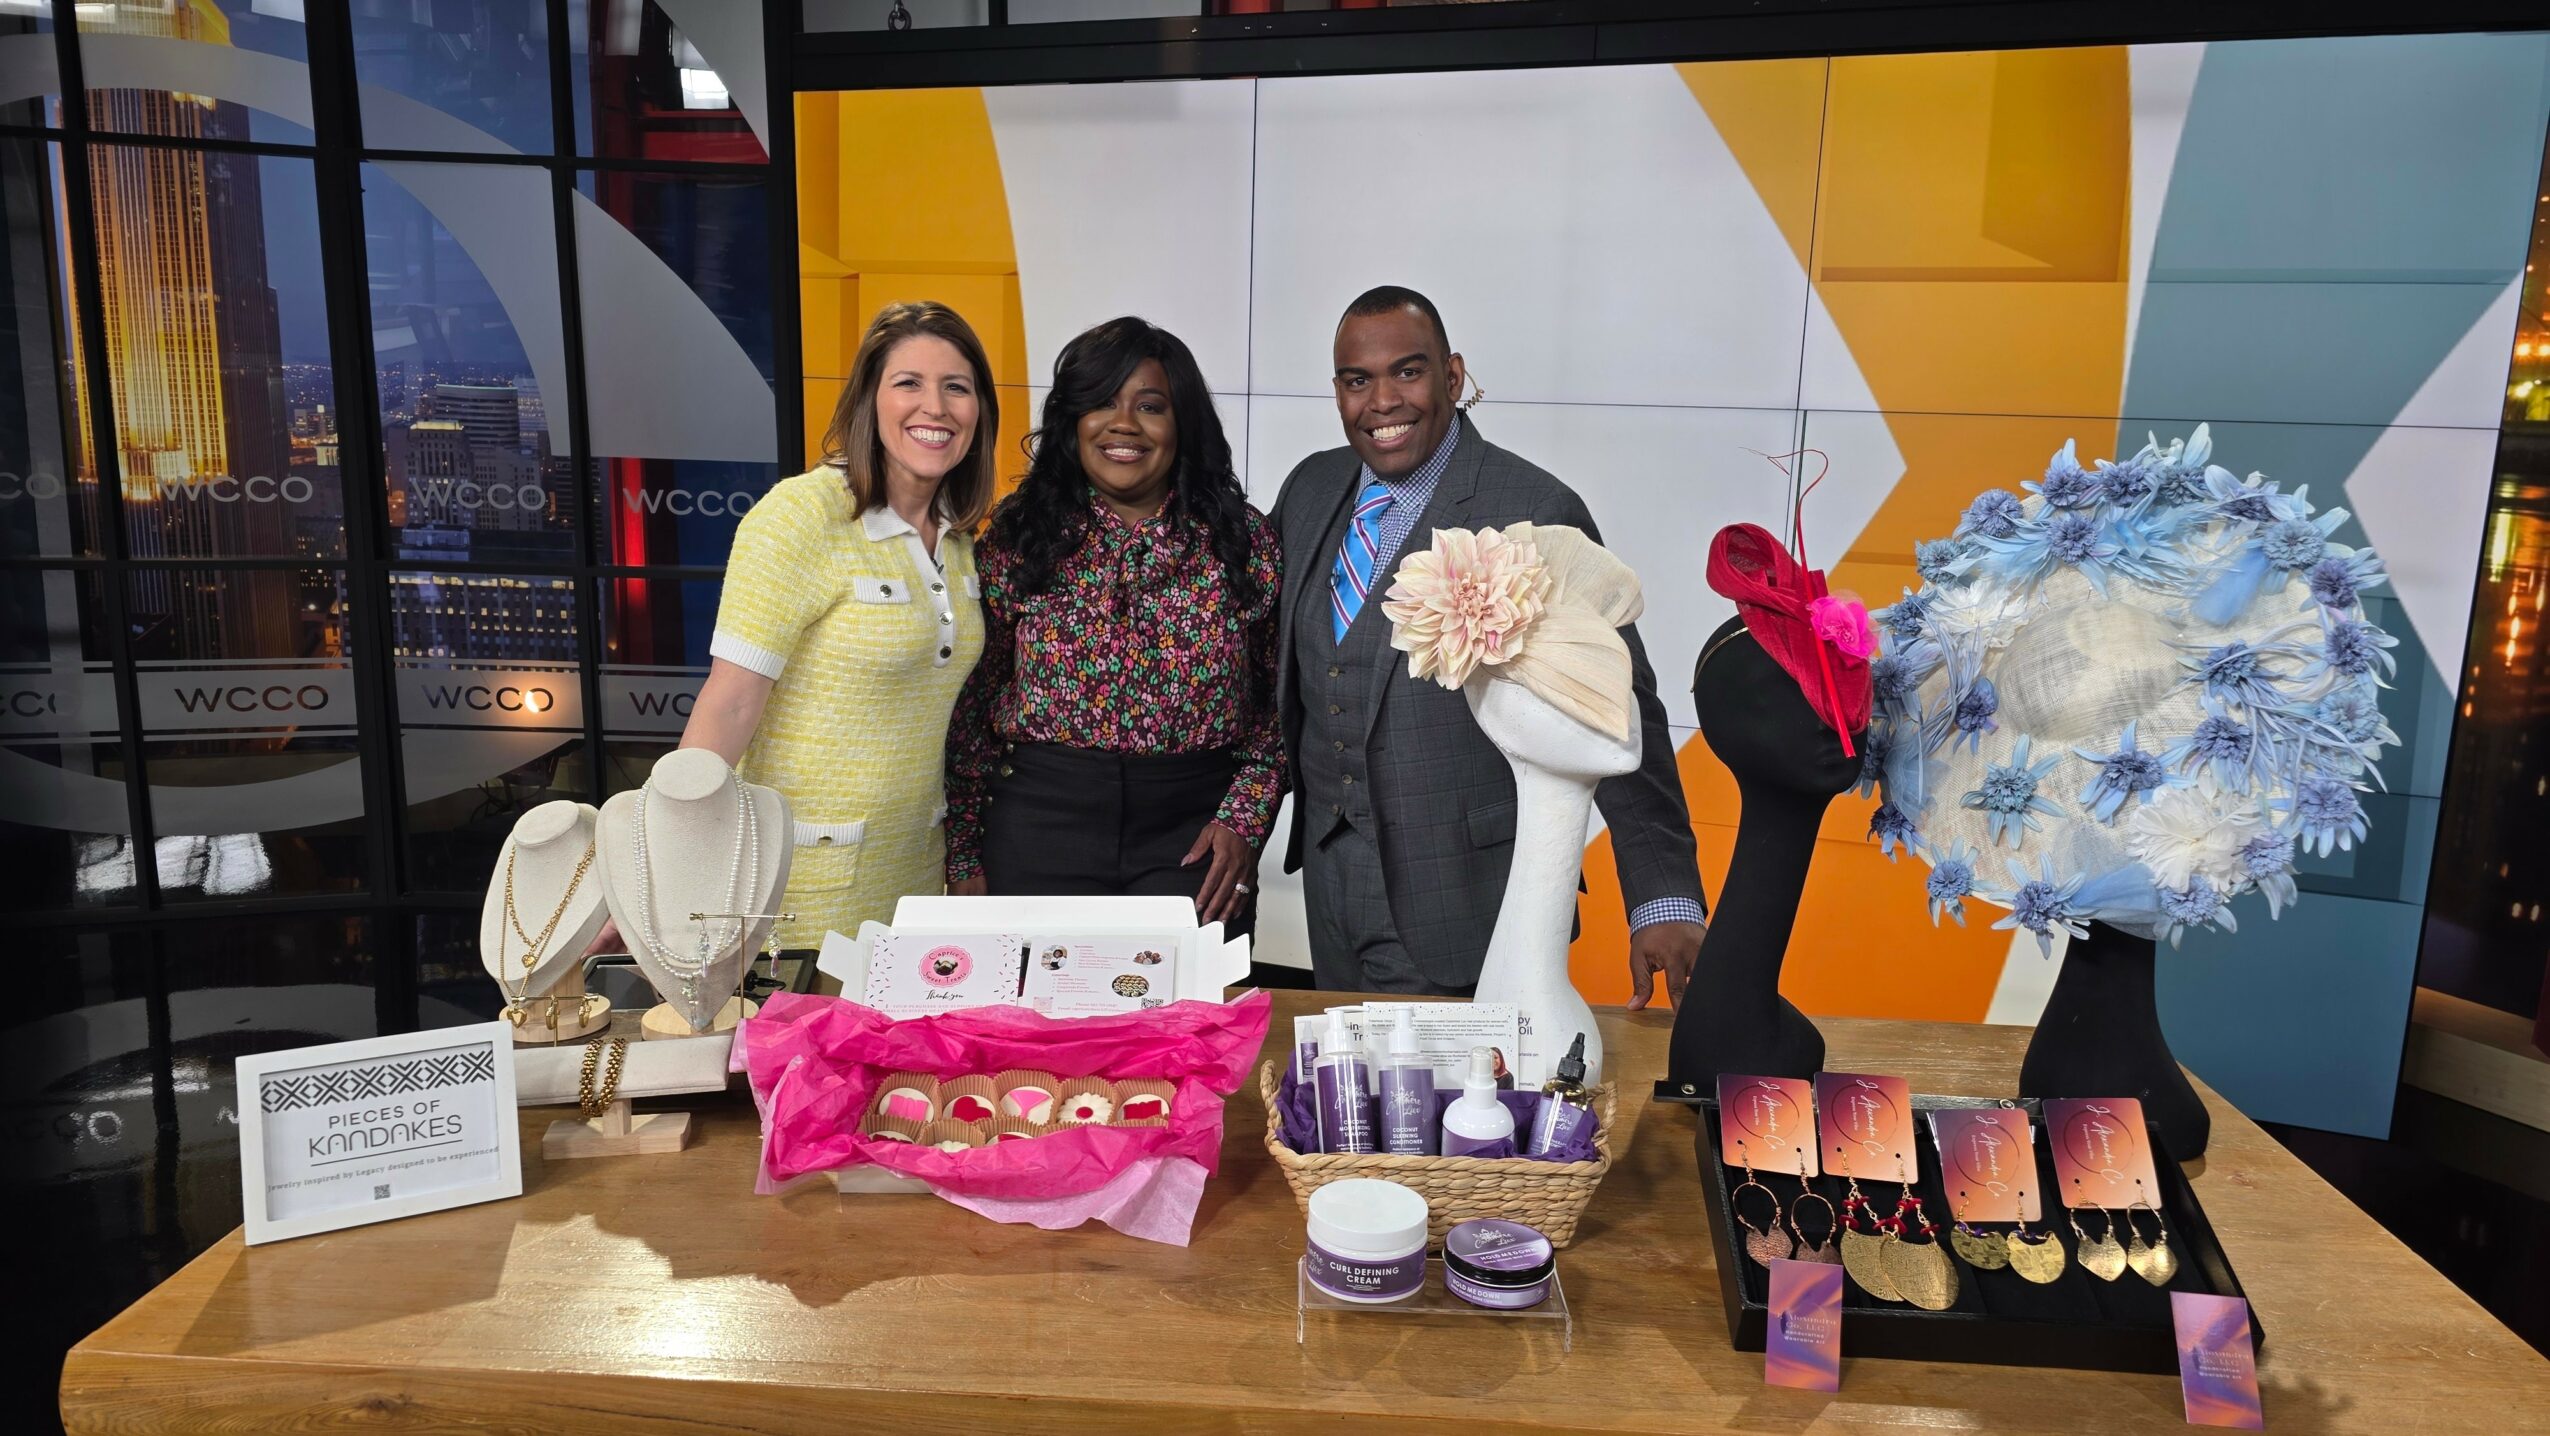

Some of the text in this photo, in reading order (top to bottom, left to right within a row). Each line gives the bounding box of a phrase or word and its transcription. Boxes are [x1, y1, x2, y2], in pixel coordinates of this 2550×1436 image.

[0, 473, 60, 500] CO
[156, 475, 313, 503] WCCO
[411, 481, 547, 511] WCCO
[623, 488, 756, 517] WCCO
[174, 685, 329, 713] WCCO
[422, 685, 554, 713] WCCO
[629, 691, 697, 717] WC
[924, 989, 964, 1001] Thank you
[1352, 1033, 1363, 1041] Tr
[1518, 1026, 1533, 1035] Oil
[328, 1100, 441, 1129] PIECES OF
[309, 1114, 462, 1158] KANDAKES
[304, 1173, 340, 1186] inspired
[343, 1171, 353, 1180] by
[356, 1165, 385, 1177] Legacy
[388, 1159, 425, 1171] designed
[427, 1156, 436, 1164] to
[438, 1154, 447, 1162] be
[450, 1146, 499, 1161] experienced
[1480, 1253, 1501, 1261] HOLD
[1512, 1247, 1536, 1256] DOWN
[1330, 1261, 1399, 1277] CURL DEFINING
[1346, 1275, 1381, 1284] CREAM
[1452, 1278, 1467, 1291] HOLD
[1467, 1287, 1476, 1295] ME
[1477, 1290, 1501, 1300] DOWN
